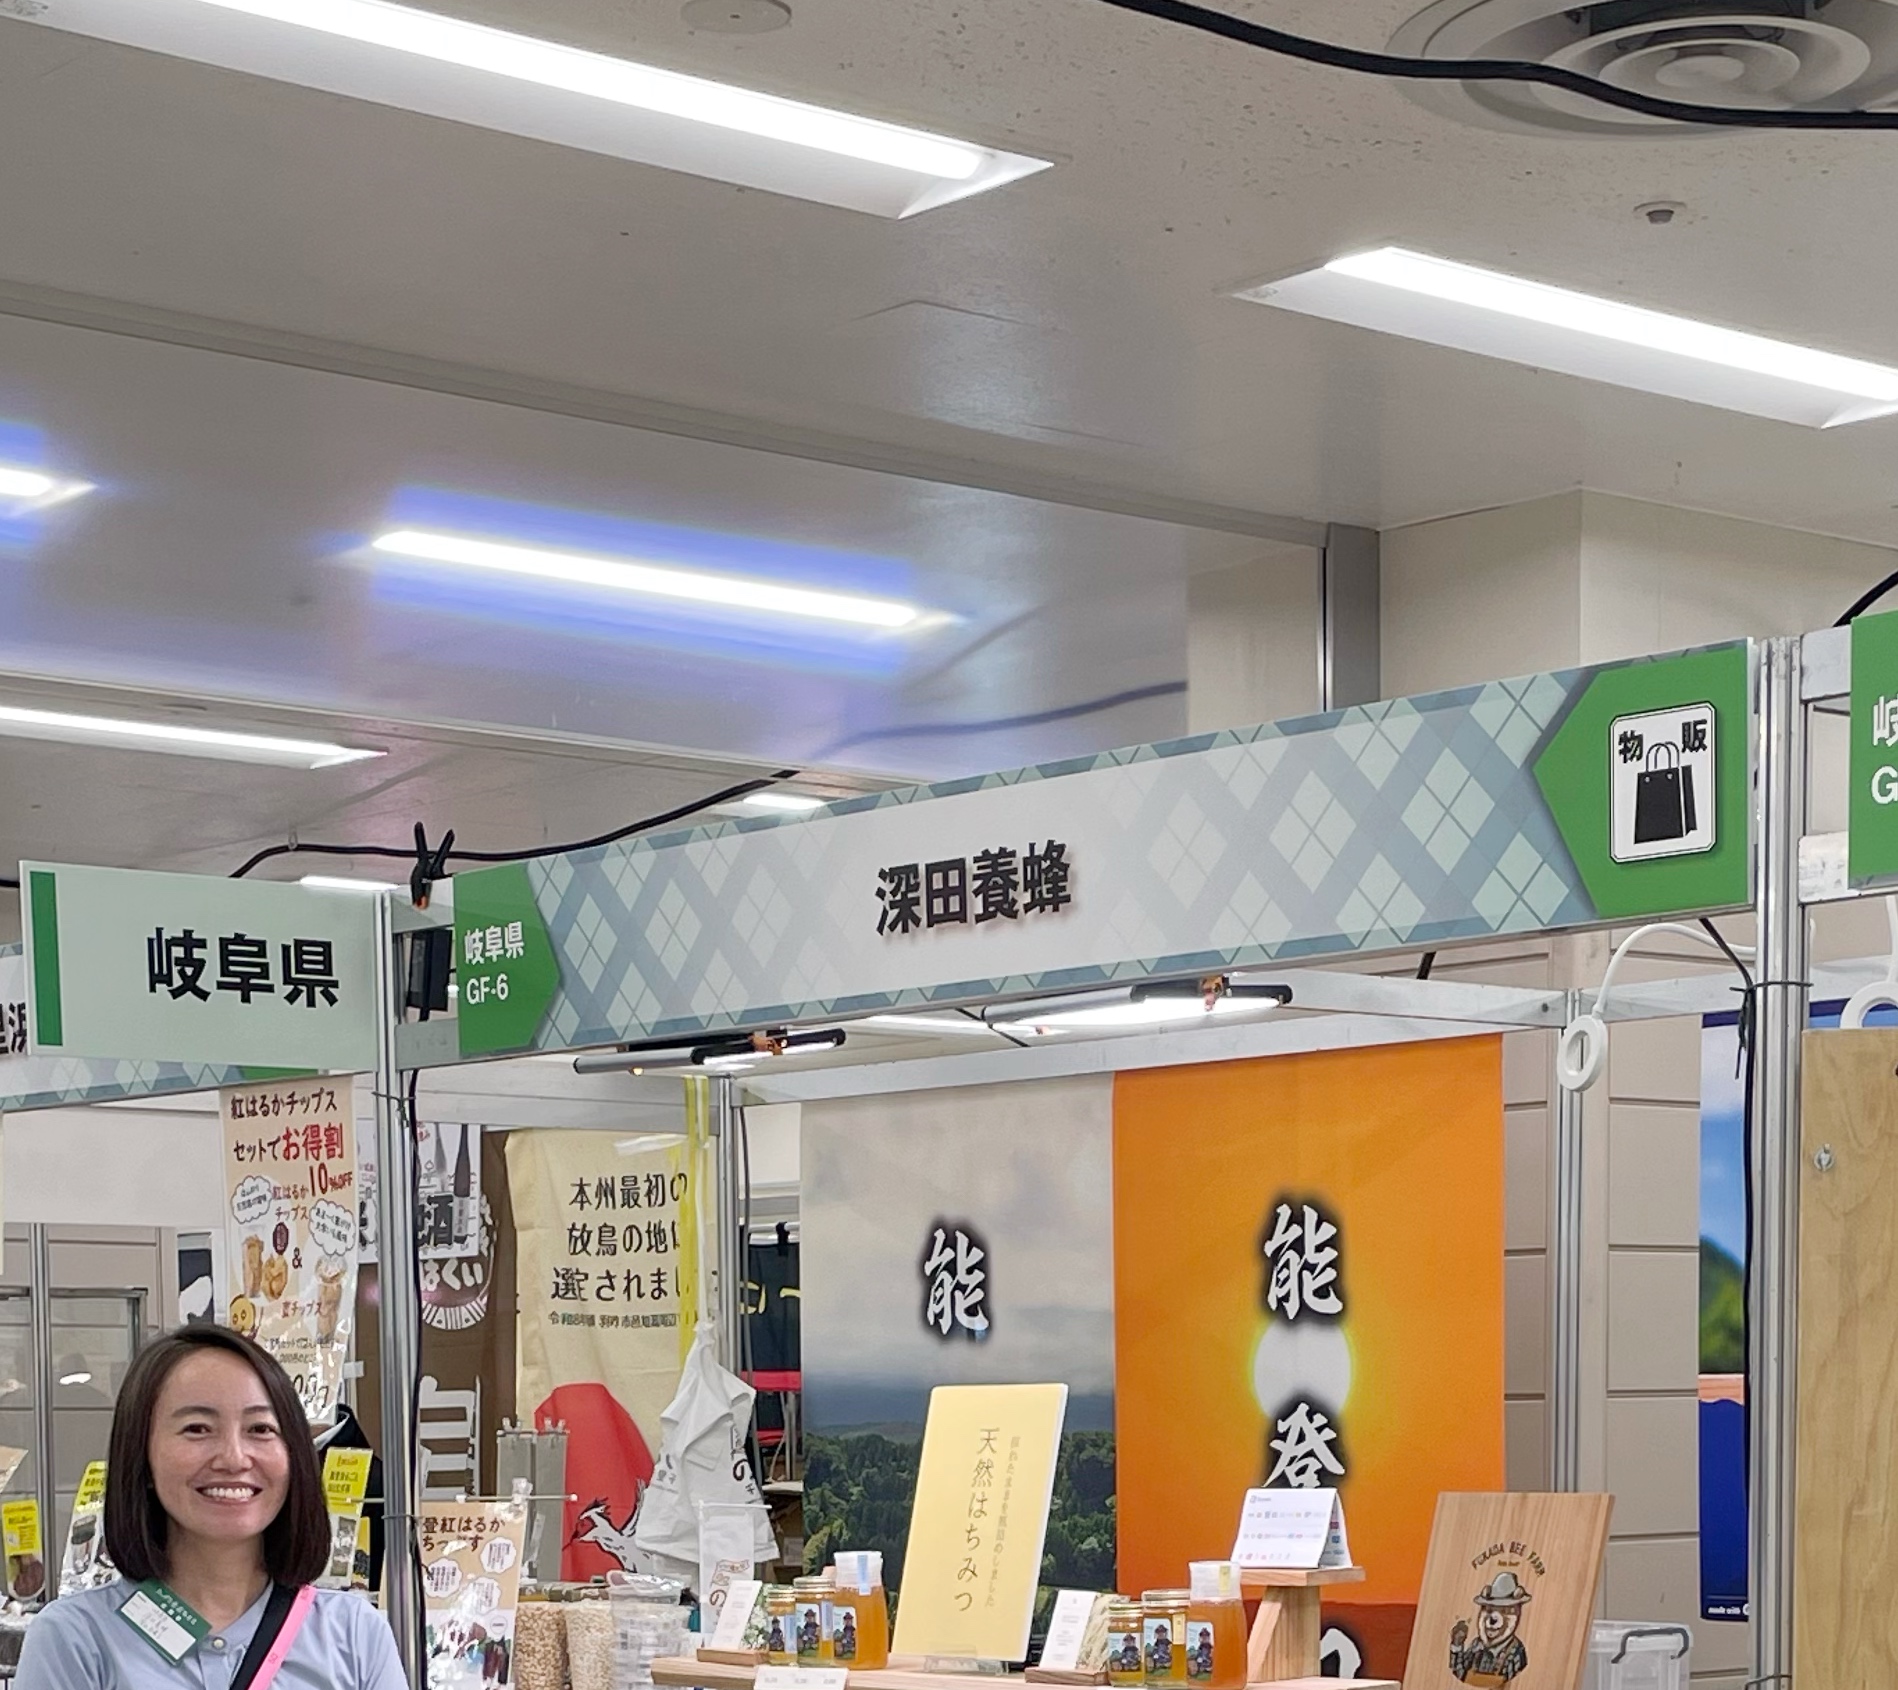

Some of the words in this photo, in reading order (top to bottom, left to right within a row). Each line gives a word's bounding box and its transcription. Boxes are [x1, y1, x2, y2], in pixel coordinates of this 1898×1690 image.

[876, 839, 1072, 937] 深田養蜂
[147, 927, 339, 1008] 岐阜県
[464, 920, 525, 965] 岐阜県
[466, 972, 509, 1005] GF-6
[231, 1087, 338, 1119] 紅はるかチップス
[924, 1228, 990, 1336] 能
[954, 1426, 1001, 1613] 天然はちみつ
